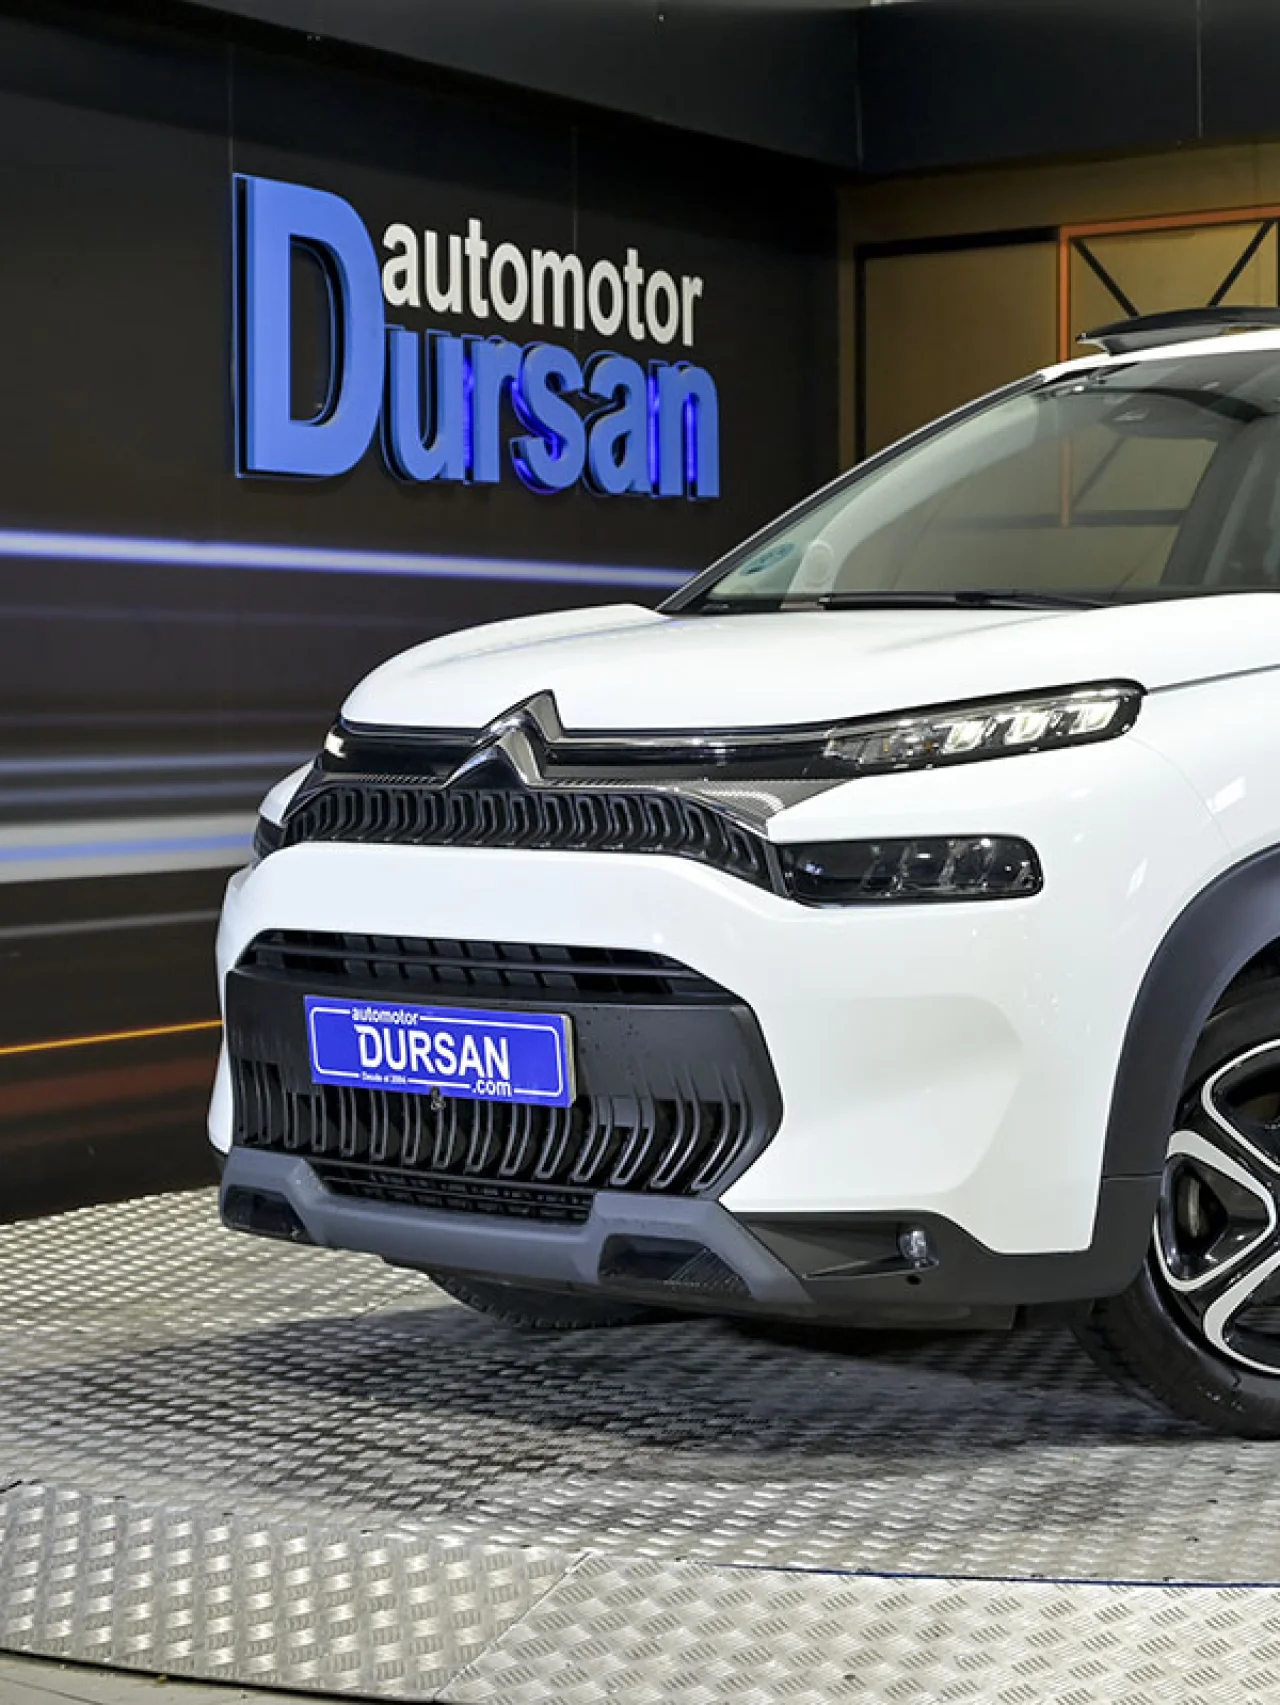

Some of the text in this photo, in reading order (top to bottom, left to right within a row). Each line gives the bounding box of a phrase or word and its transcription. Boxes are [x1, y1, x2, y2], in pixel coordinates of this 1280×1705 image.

[382, 218, 704, 347] automotor
[233, 172, 721, 500] Dursan
[351, 1007, 418, 1025] automotor
[353, 1024, 510, 1080] DURSAN
[471, 1079, 512, 1097] .com
